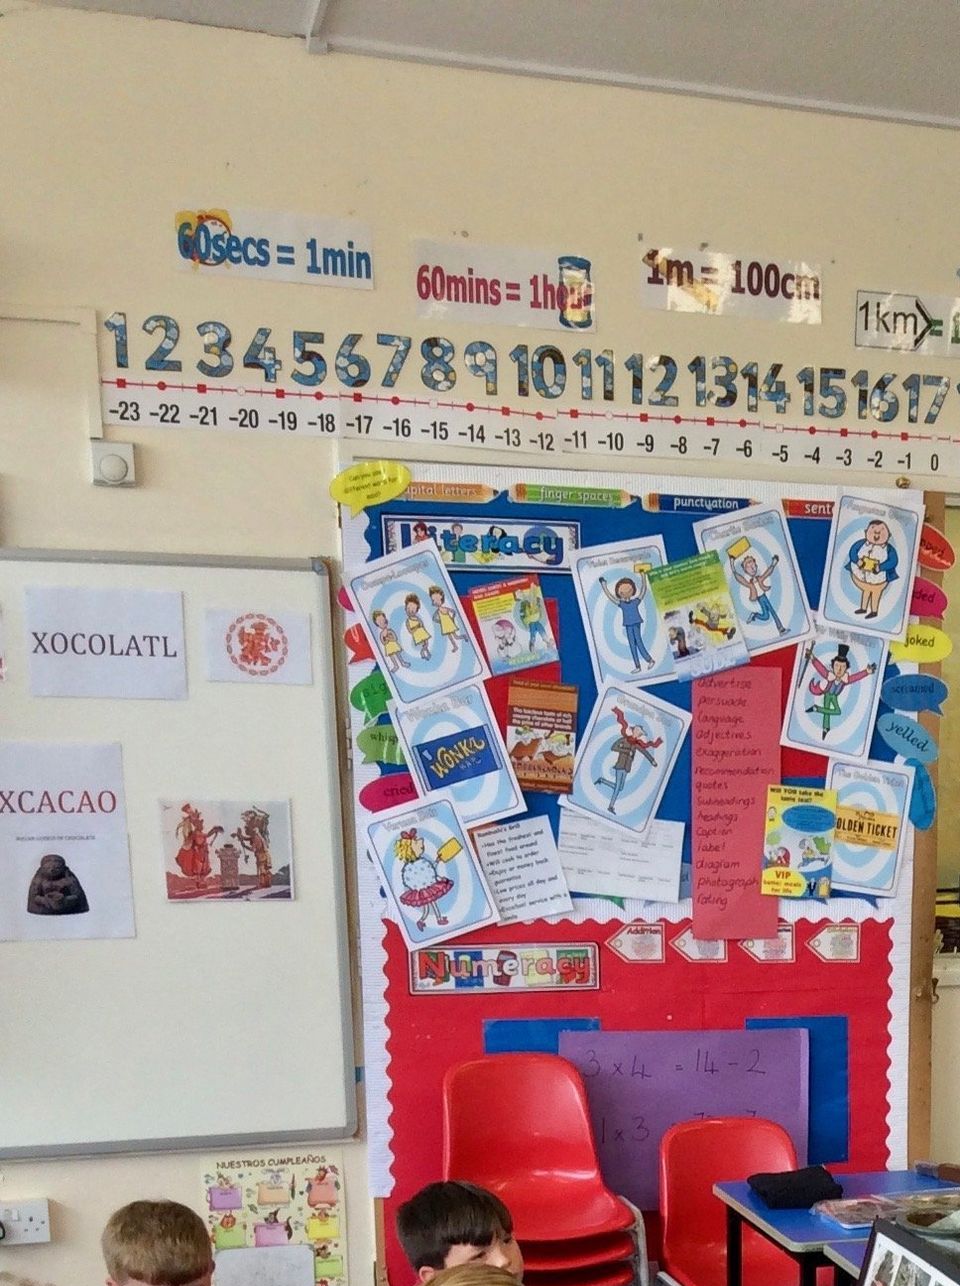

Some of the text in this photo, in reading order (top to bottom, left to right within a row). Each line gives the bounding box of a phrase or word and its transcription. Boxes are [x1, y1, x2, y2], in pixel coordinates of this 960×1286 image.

[177, 222, 372, 280] 60secs 1min
[416, 264, 501, 306] 60mins
[731, 261, 821, 300] 100cm
[858, 301, 917, 335] 1km
[104, 312, 129, 369] 1
[142, 314, 183, 372] 2
[196, 320, 234, 377] 3
[242, 327, 282, 383] 4
[291, 331, 328, 387] 5
[334, 333, 372, 388] 6
[376, 333, 412, 388] 7
[420, 336, 455, 392] 8
[463, 340, 498, 396] 9
[508, 344, 567, 399] 10
[574, 348, 615, 401] 11
[624, 352, 679, 407] 12
[687, 355, 738, 408] 13
[739, 361, 791, 413] 14
[796, 366, 846, 420] 15
[851, 368, 898, 422] 16
[902, 373, 951, 424] 17
[109, 401, 140, 421] -23
[150, 404, 180, 423] -22
[190, 406, 217, 425] -21
[229, 409, 258, 428] -20
[269, 411, 297, 430] -19
[308, 414, 335, 432] -18
[346, 415, 373, 434] -17
[383, 418, 411, 437] -16
[421, 421, 448, 440] -15
[459, 424, 485, 443] -14
[495, 428, 520, 446] -13
[530, 433, 554, 451] -12
[565, 431, 586, 448] -11
[598, 433, 623, 451] -10
[637, 435, 654, 452] -9
[671, 436, 687, 454] -8
[704, 438, 720, 455] -7
[736, 440, 752, 457] -6
[772, 445, 788, 462] -5
[805, 447, 820, 464] -4
[836, 449, 851, 466] -3
[868, 451, 882, 468] -2
[898, 453, 910, 469] -1
[931, 454, 938, 471] 0
[405, 484, 437, 498] apital
[440, 485, 477, 497] letters
[540, 487, 613, 503] finger spaces
[673, 497, 739, 510] punctuation
[804, 502, 832, 514] sent
[32, 632, 178, 658] XOCOLATL
[904, 634, 935, 648] joked
[370, 732, 398, 746] whisp
[886, 720, 929, 753] yelled
[430, 736, 486, 779] WONKA
[383, 781, 414, 797] cried
[696, 779, 729, 793] quotes
[836, 817, 898, 839] OLDEN TICKET
[775, 870, 791, 880] VIP
[418, 950, 591, 985] Numeracy
[582, 1049, 767, 1079] 3 4 14 2
[631, 1116, 650, 1142] 3
[216, 1155, 327, 1170] NUESTROS CUMPLEAÑOS
